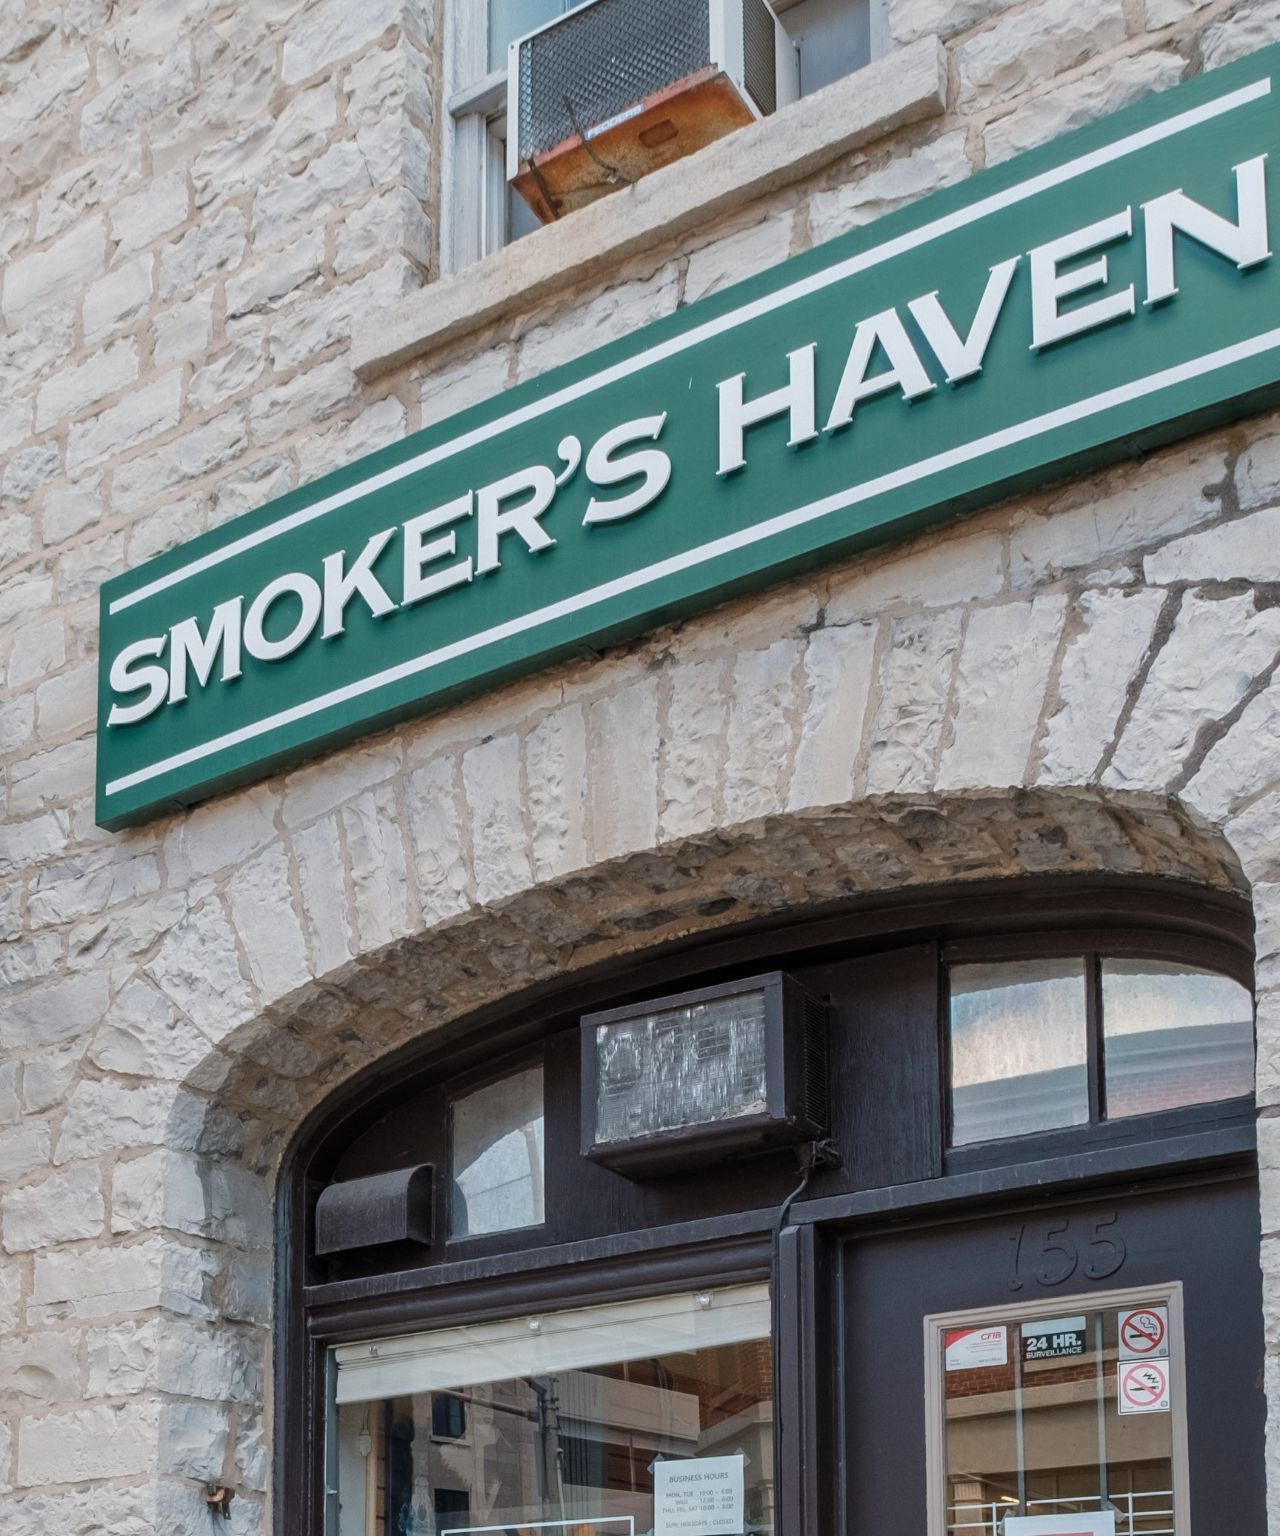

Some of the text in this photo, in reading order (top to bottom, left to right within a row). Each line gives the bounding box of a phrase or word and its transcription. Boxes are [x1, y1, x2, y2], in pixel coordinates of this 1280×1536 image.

[715, 153, 1274, 476] HAVEN
[1007, 1212, 1127, 1292] 155
[1026, 1333, 1082, 1352] 24 HR.
[1026, 1346, 1083, 1359] SURVEILLANCE
[669, 1472, 729, 1483] BUSINESS HOURS
